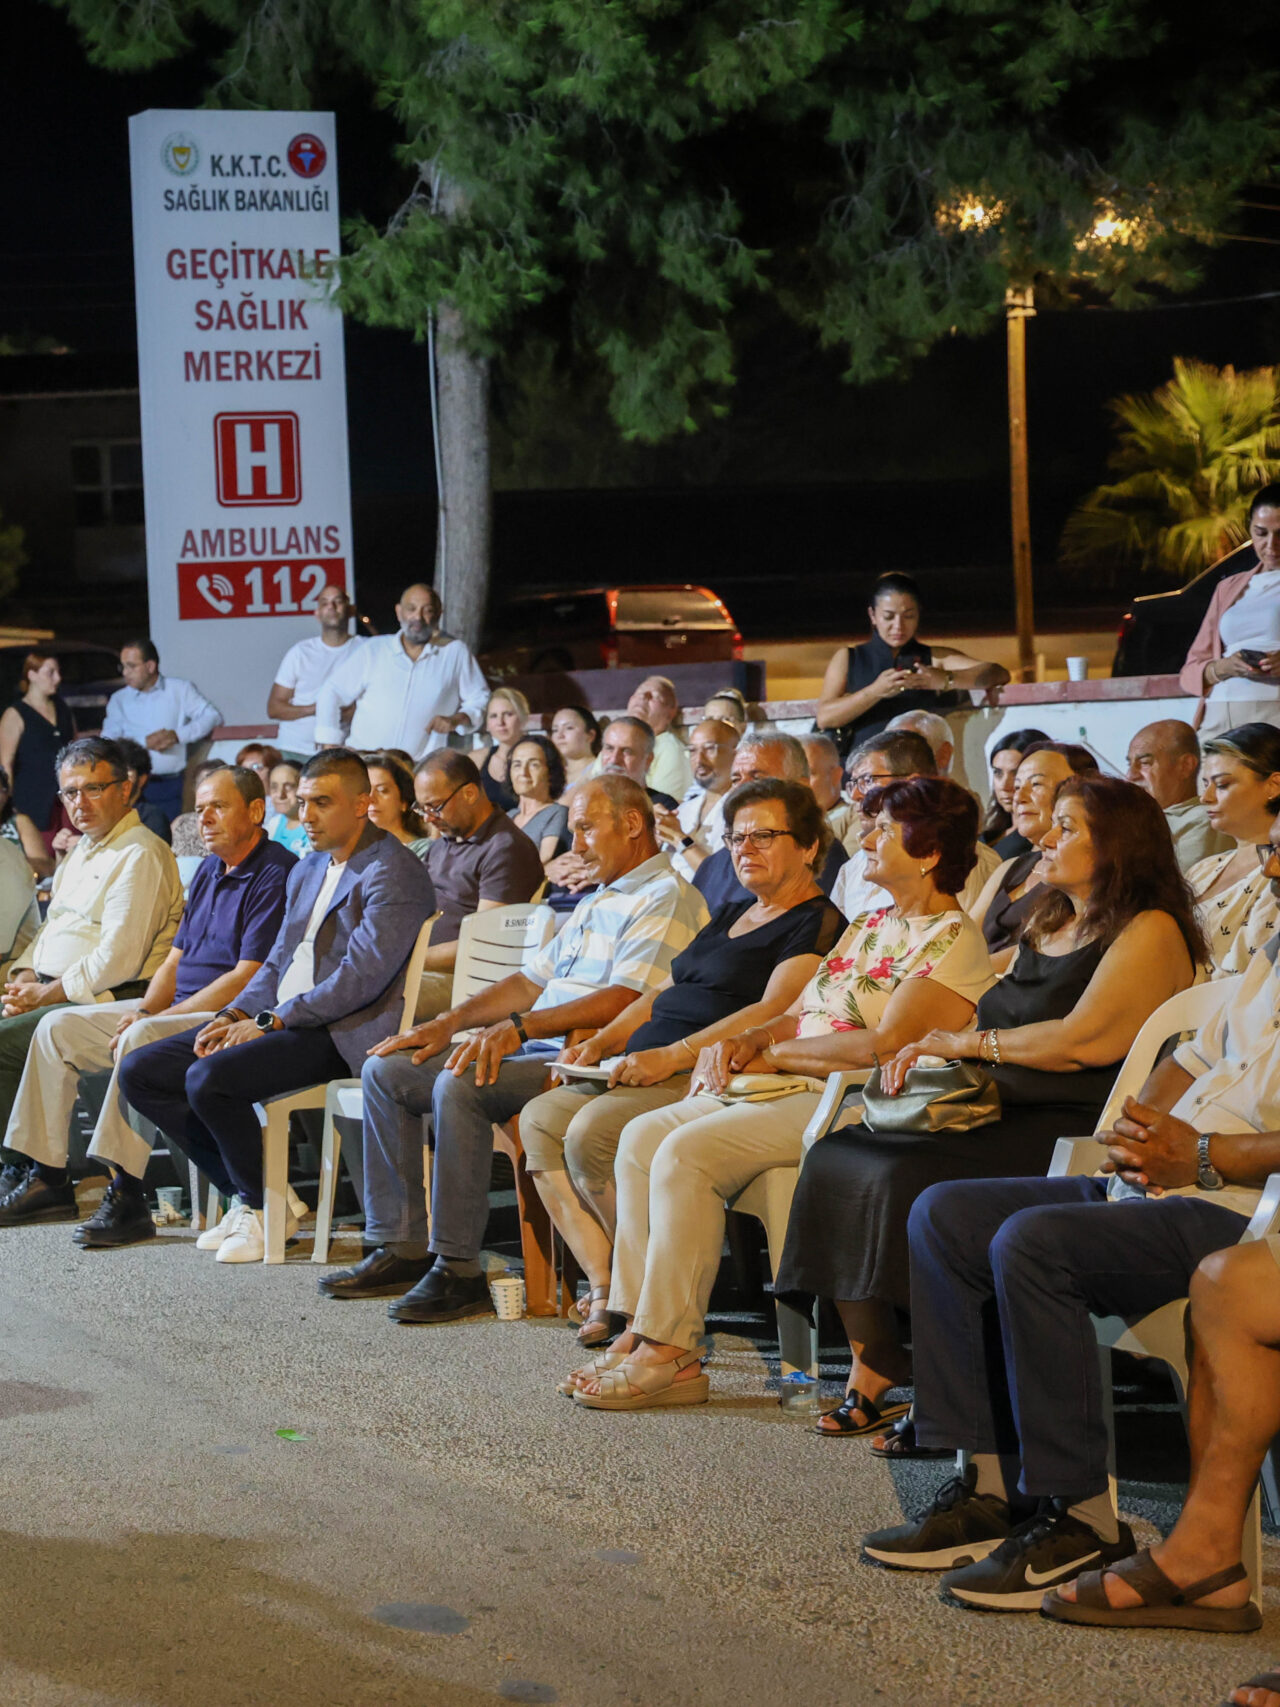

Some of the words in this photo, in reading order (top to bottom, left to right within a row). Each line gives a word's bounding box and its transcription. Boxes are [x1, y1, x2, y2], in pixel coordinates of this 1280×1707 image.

[210, 154, 287, 178] K.K.T.C.
[163, 184, 231, 212] SAĞLIK
[234, 184, 330, 212] BAKANLIĞI
[166, 241, 331, 289] GEÇİTKALE
[194, 291, 309, 331] SAĞLIK
[183, 342, 322, 382] MERKEZİ
[180, 525, 341, 558] AMBULANS
[244, 564, 327, 614] 112
